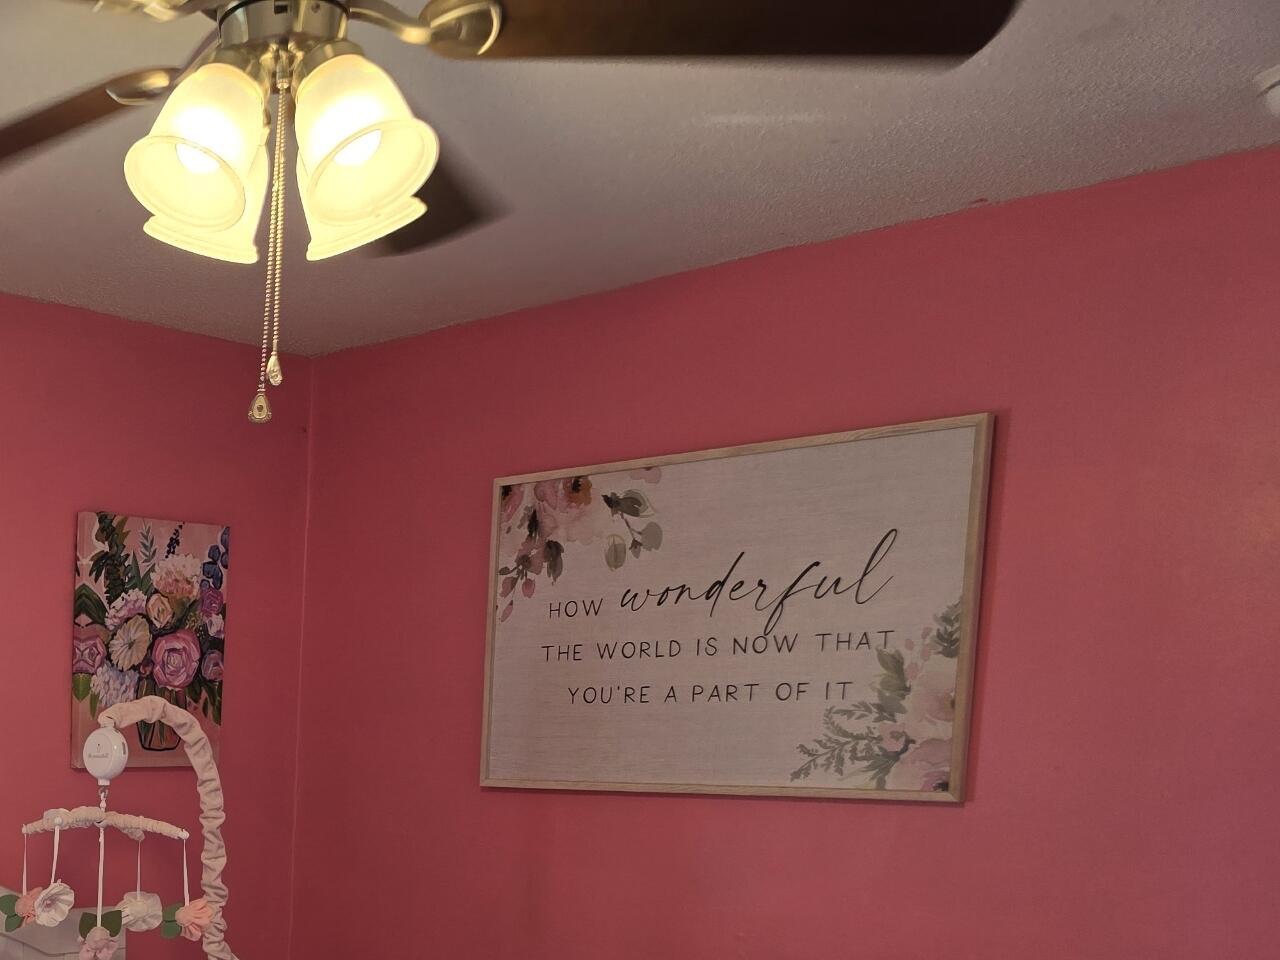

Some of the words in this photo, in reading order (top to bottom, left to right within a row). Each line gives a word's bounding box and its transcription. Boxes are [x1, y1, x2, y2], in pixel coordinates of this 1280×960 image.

[549, 598, 604, 620] HOW
[619, 528, 899, 636] wonderful
[541, 644, 583, 662] THE
[596, 639, 682, 660] WORLD
[696, 637, 718, 657] IS
[732, 633, 799, 656] NOW
[815, 630, 895, 652] THAT
[567, 685, 651, 705] YOU'RE
[663, 685, 678, 704] A
[691, 683, 760, 703] PART
[775, 682, 810, 702] OF
[825, 681, 854, 701] IT
